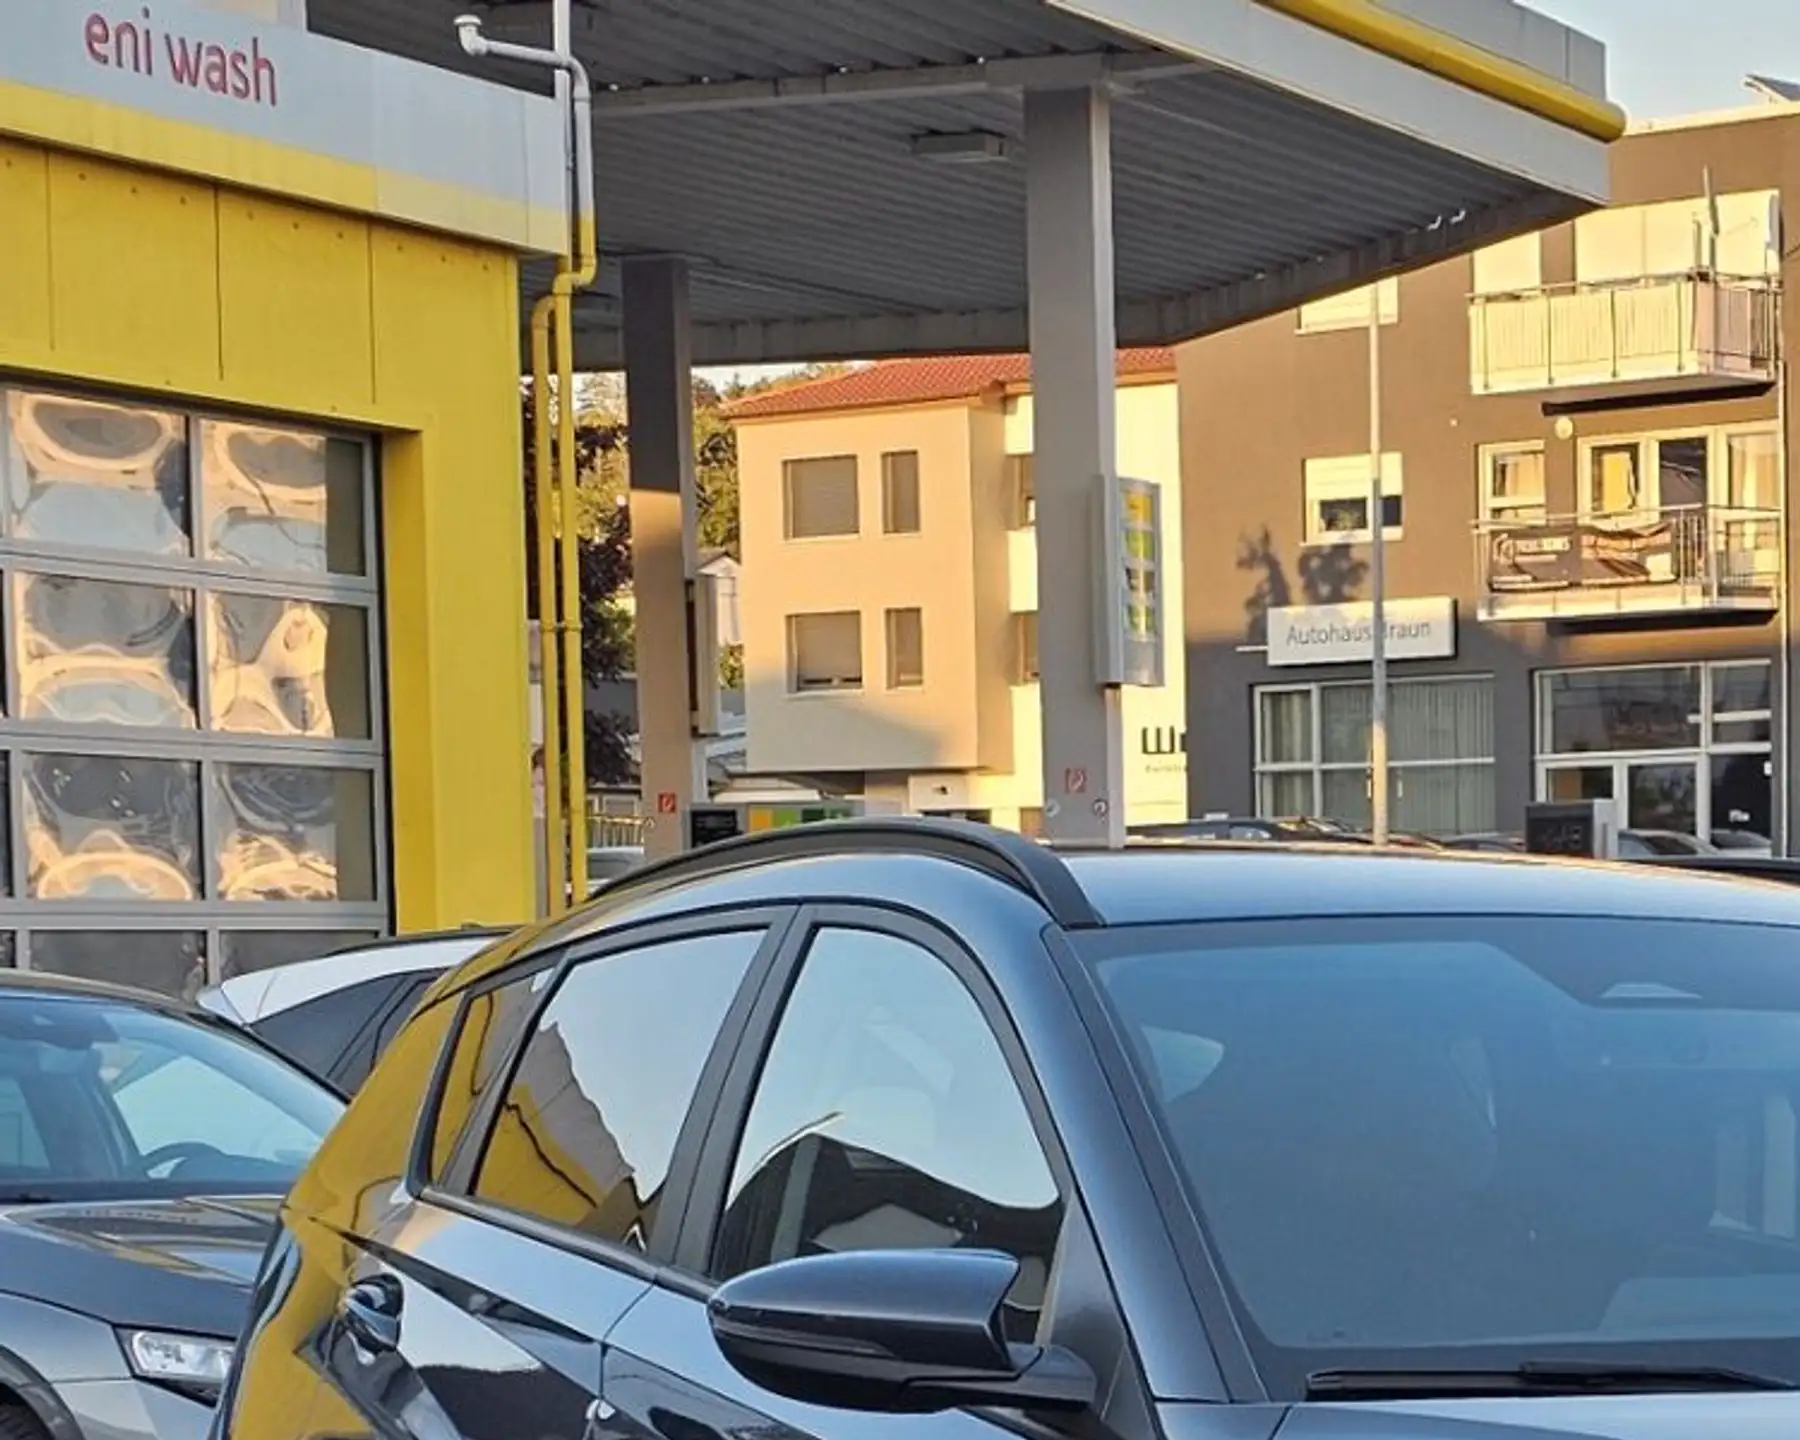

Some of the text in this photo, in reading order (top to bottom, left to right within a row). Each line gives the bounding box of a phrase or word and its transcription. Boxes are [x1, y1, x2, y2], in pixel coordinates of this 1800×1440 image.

[84, 6, 277, 107] eni wash
[1286, 621, 1433, 647] Autohaus raun
